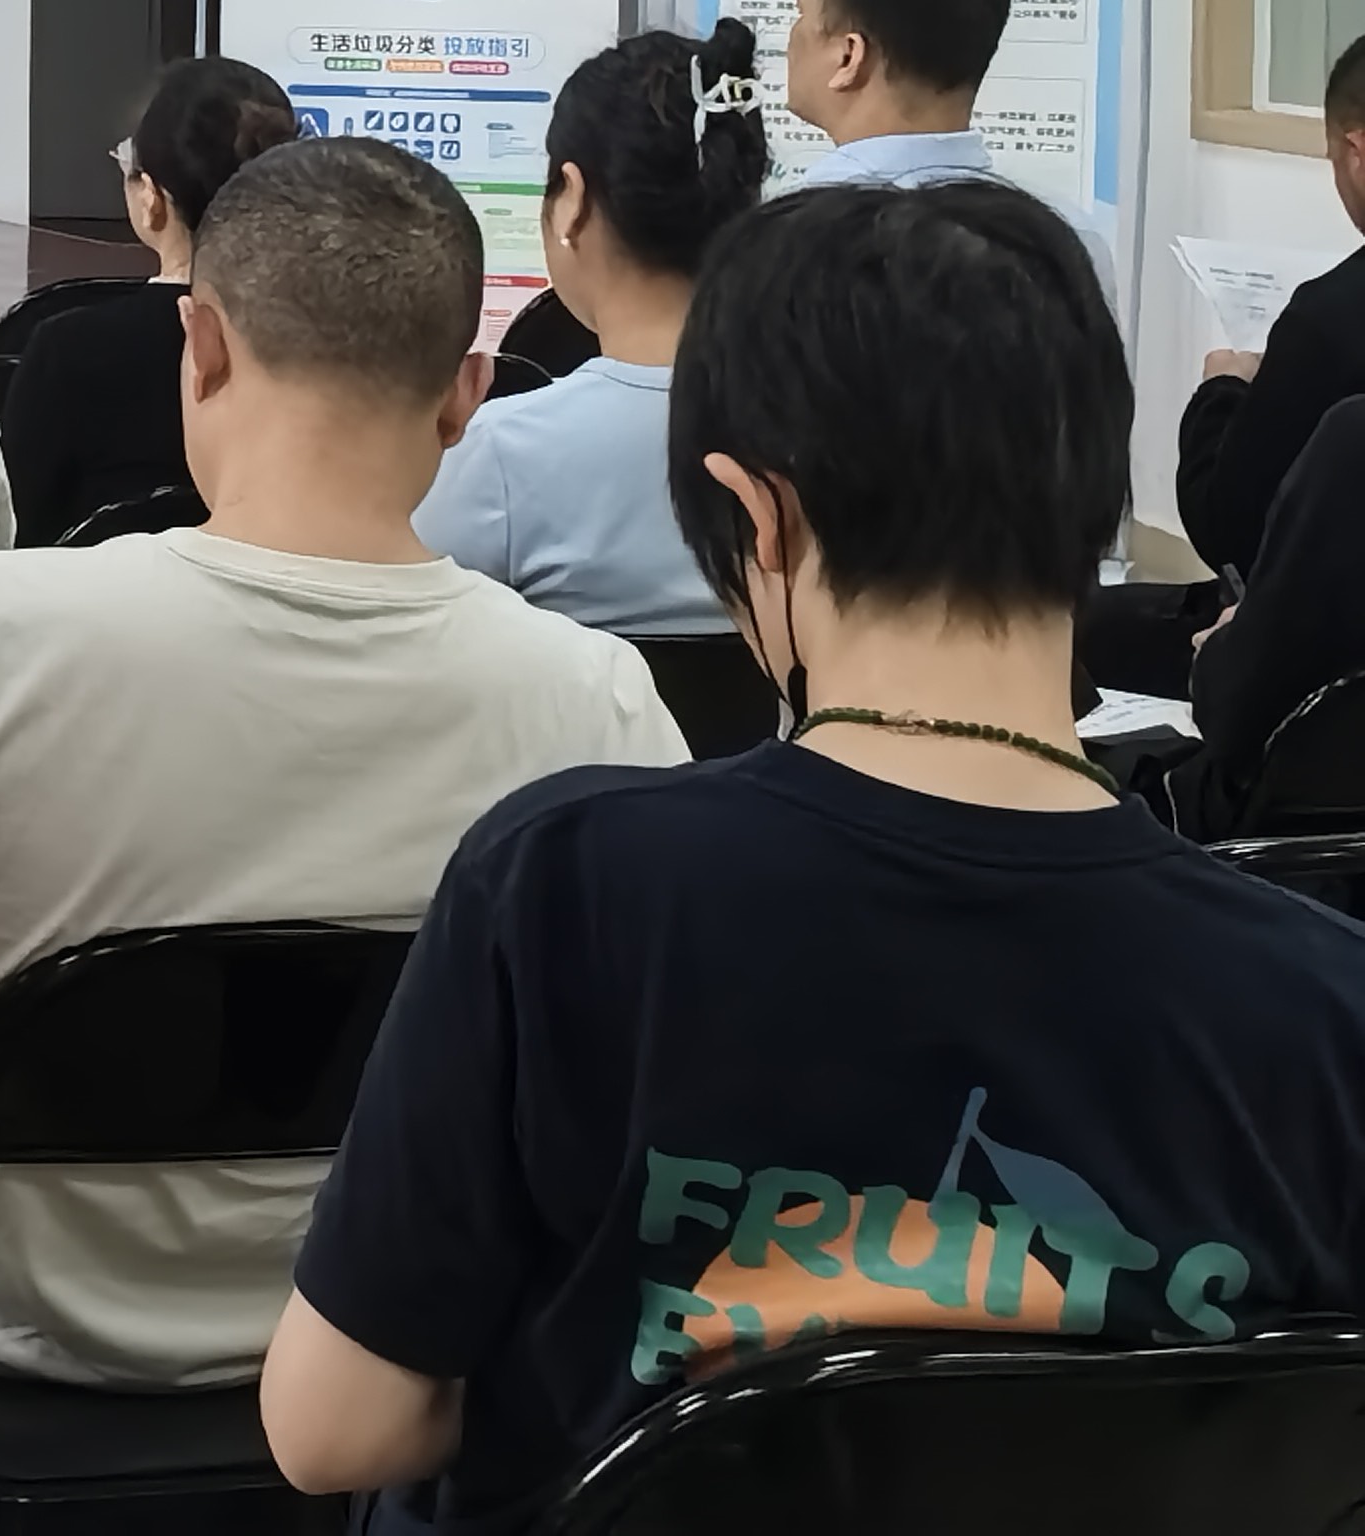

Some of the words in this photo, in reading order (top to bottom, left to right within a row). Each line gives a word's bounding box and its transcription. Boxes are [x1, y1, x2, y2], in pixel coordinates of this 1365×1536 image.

[309, 33, 437, 56] 生活垃圾分类
[443, 36, 531, 58] 投放指引
[638, 1146, 1251, 1342] FRUITS
